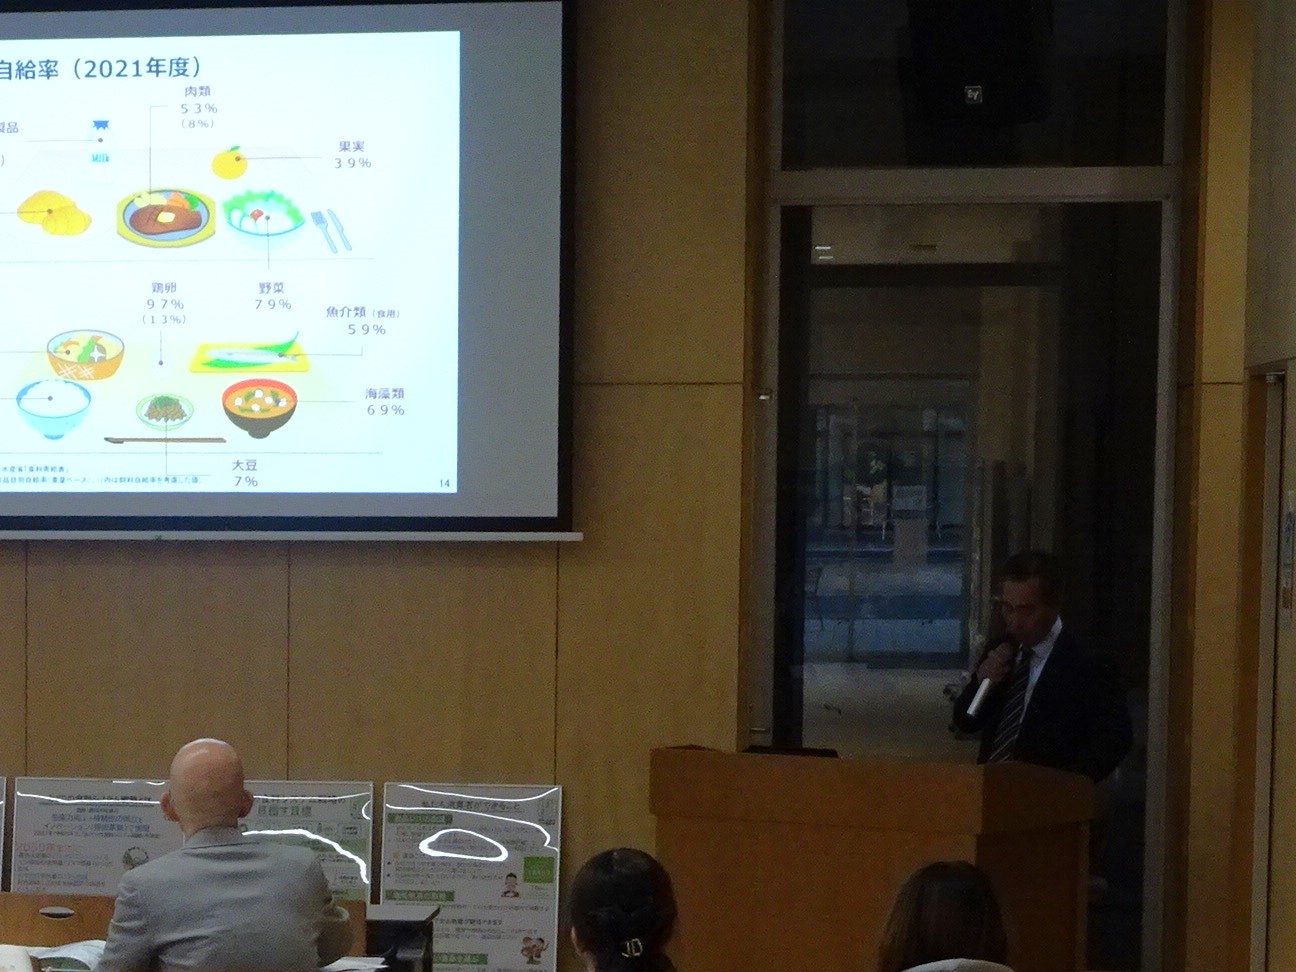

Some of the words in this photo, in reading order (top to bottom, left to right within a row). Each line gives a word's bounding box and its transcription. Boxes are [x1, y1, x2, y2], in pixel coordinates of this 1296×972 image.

[184, 85, 211, 98] 肉類
[339, 141, 365, 153] 果実
[151, 282, 177, 294] 鶏卵
[258, 282, 285, 294] 野菜
[365, 388, 405, 400] 海藻類
[232, 459, 257, 471] 大豆
[234, 476, 258, 487] 7%
[439, 479, 450, 488] 14
